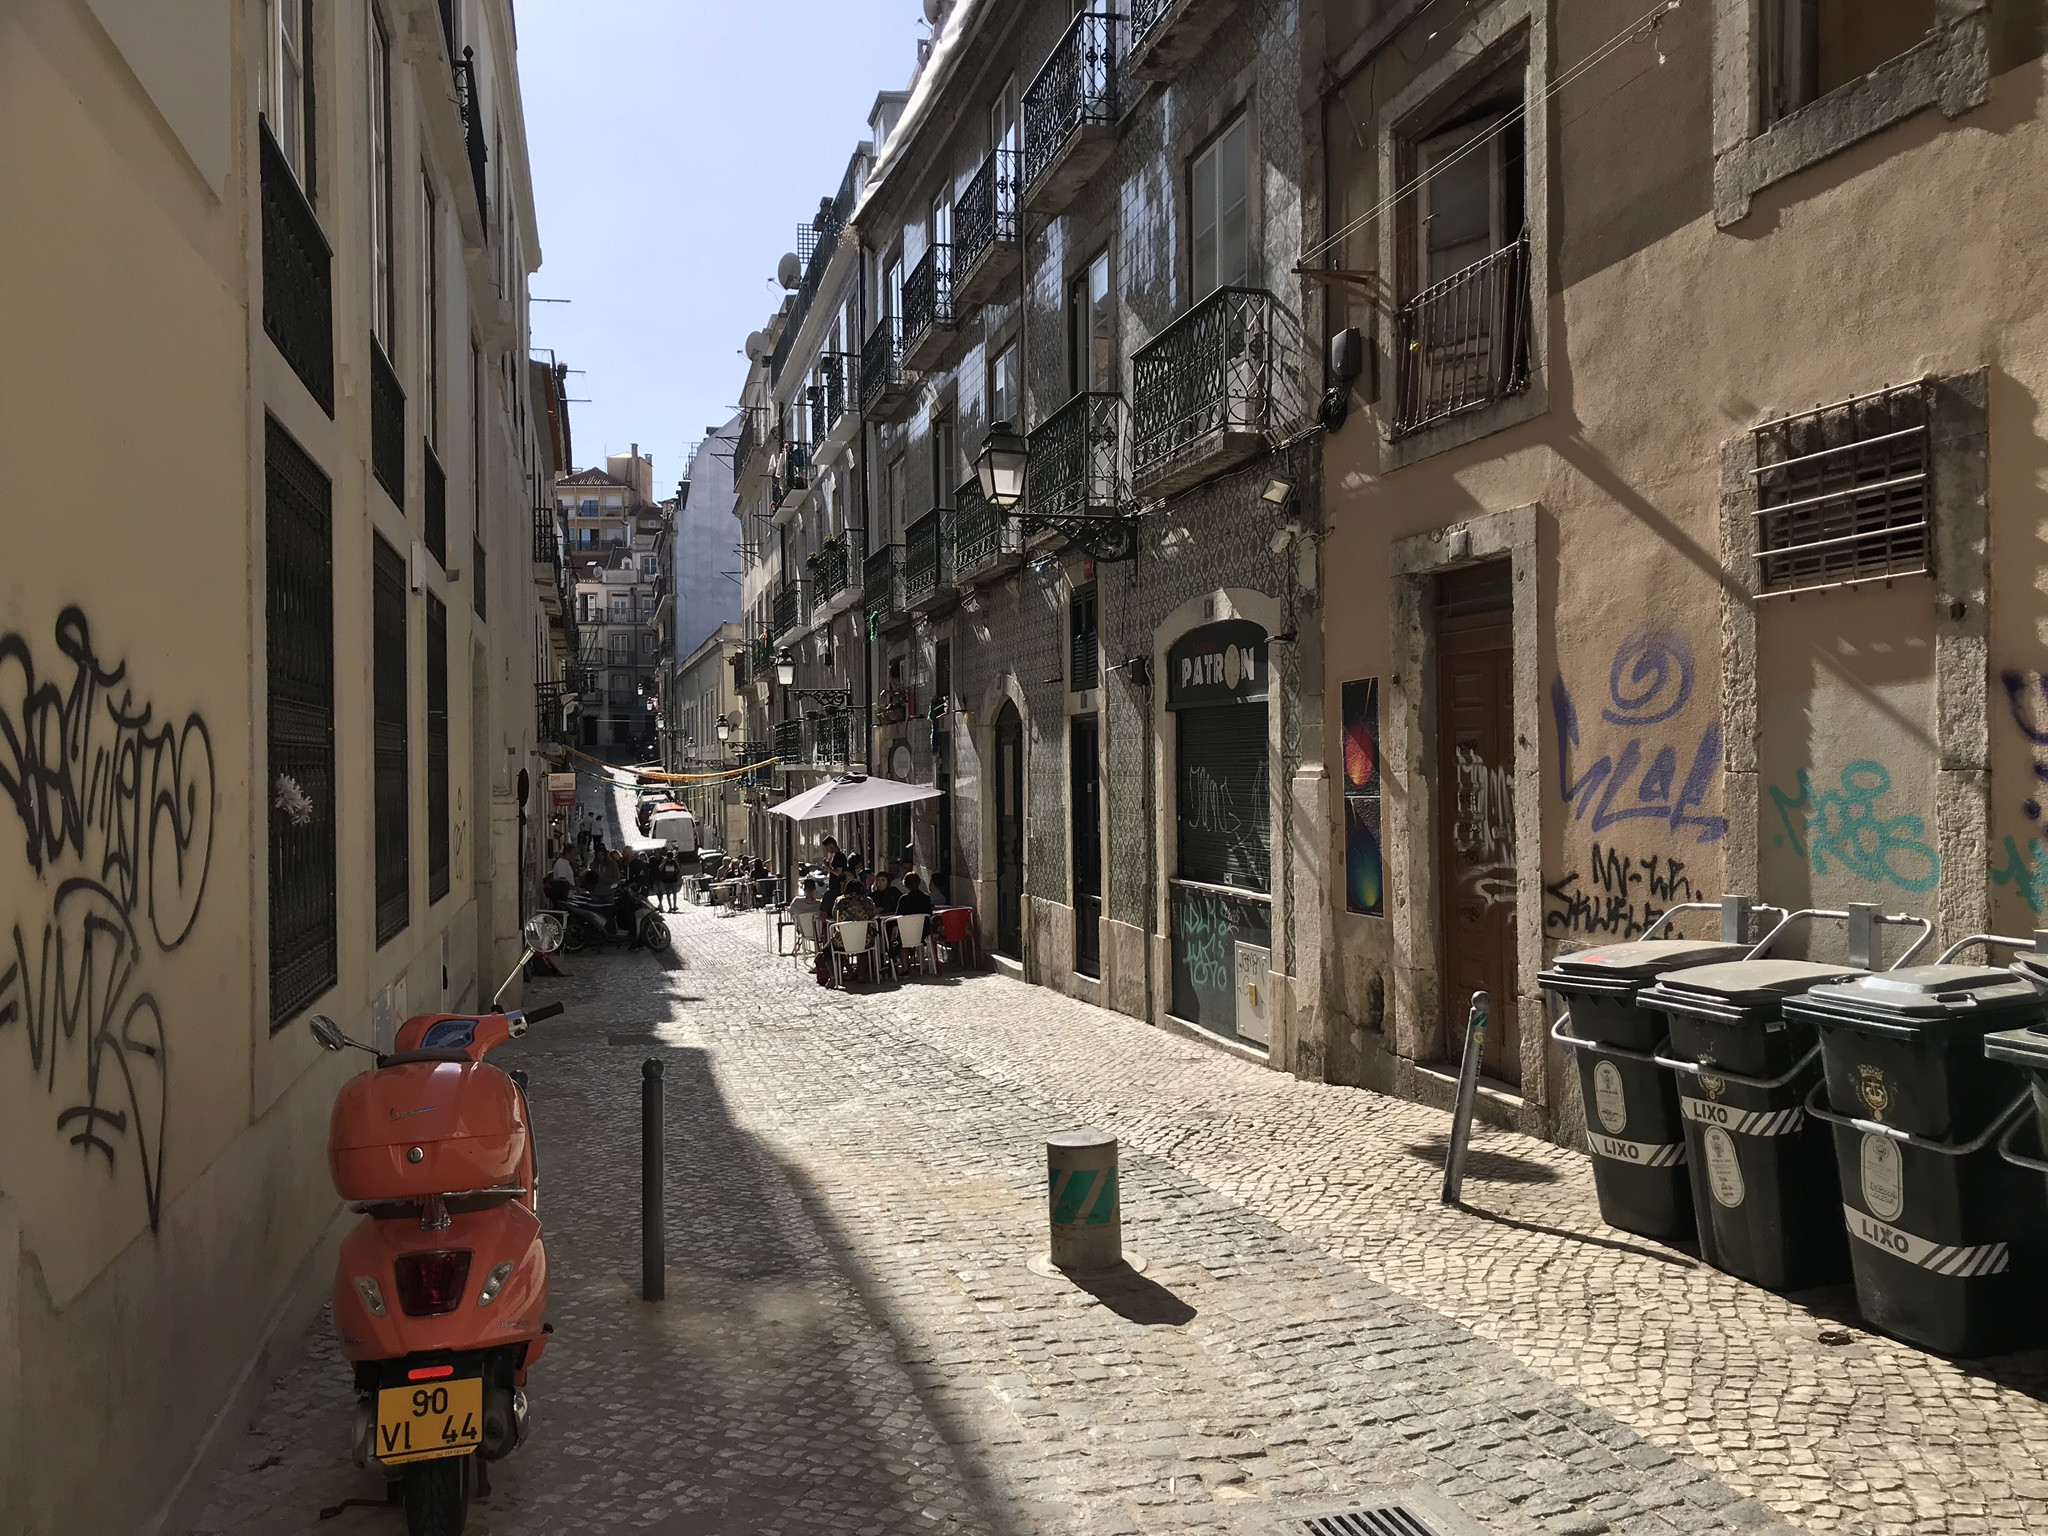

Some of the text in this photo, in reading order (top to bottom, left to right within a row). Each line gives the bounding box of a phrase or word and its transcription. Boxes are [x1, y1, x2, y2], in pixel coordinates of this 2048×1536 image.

[1182, 644, 1255, 689] PATRON
[1693, 1102, 1728, 1124] LIXO
[1603, 1139, 1640, 1160] LIXO
[1862, 1218, 1909, 1254] LIXO
[412, 1387, 448, 1417] 90
[380, 1412, 478, 1452] VI 44
